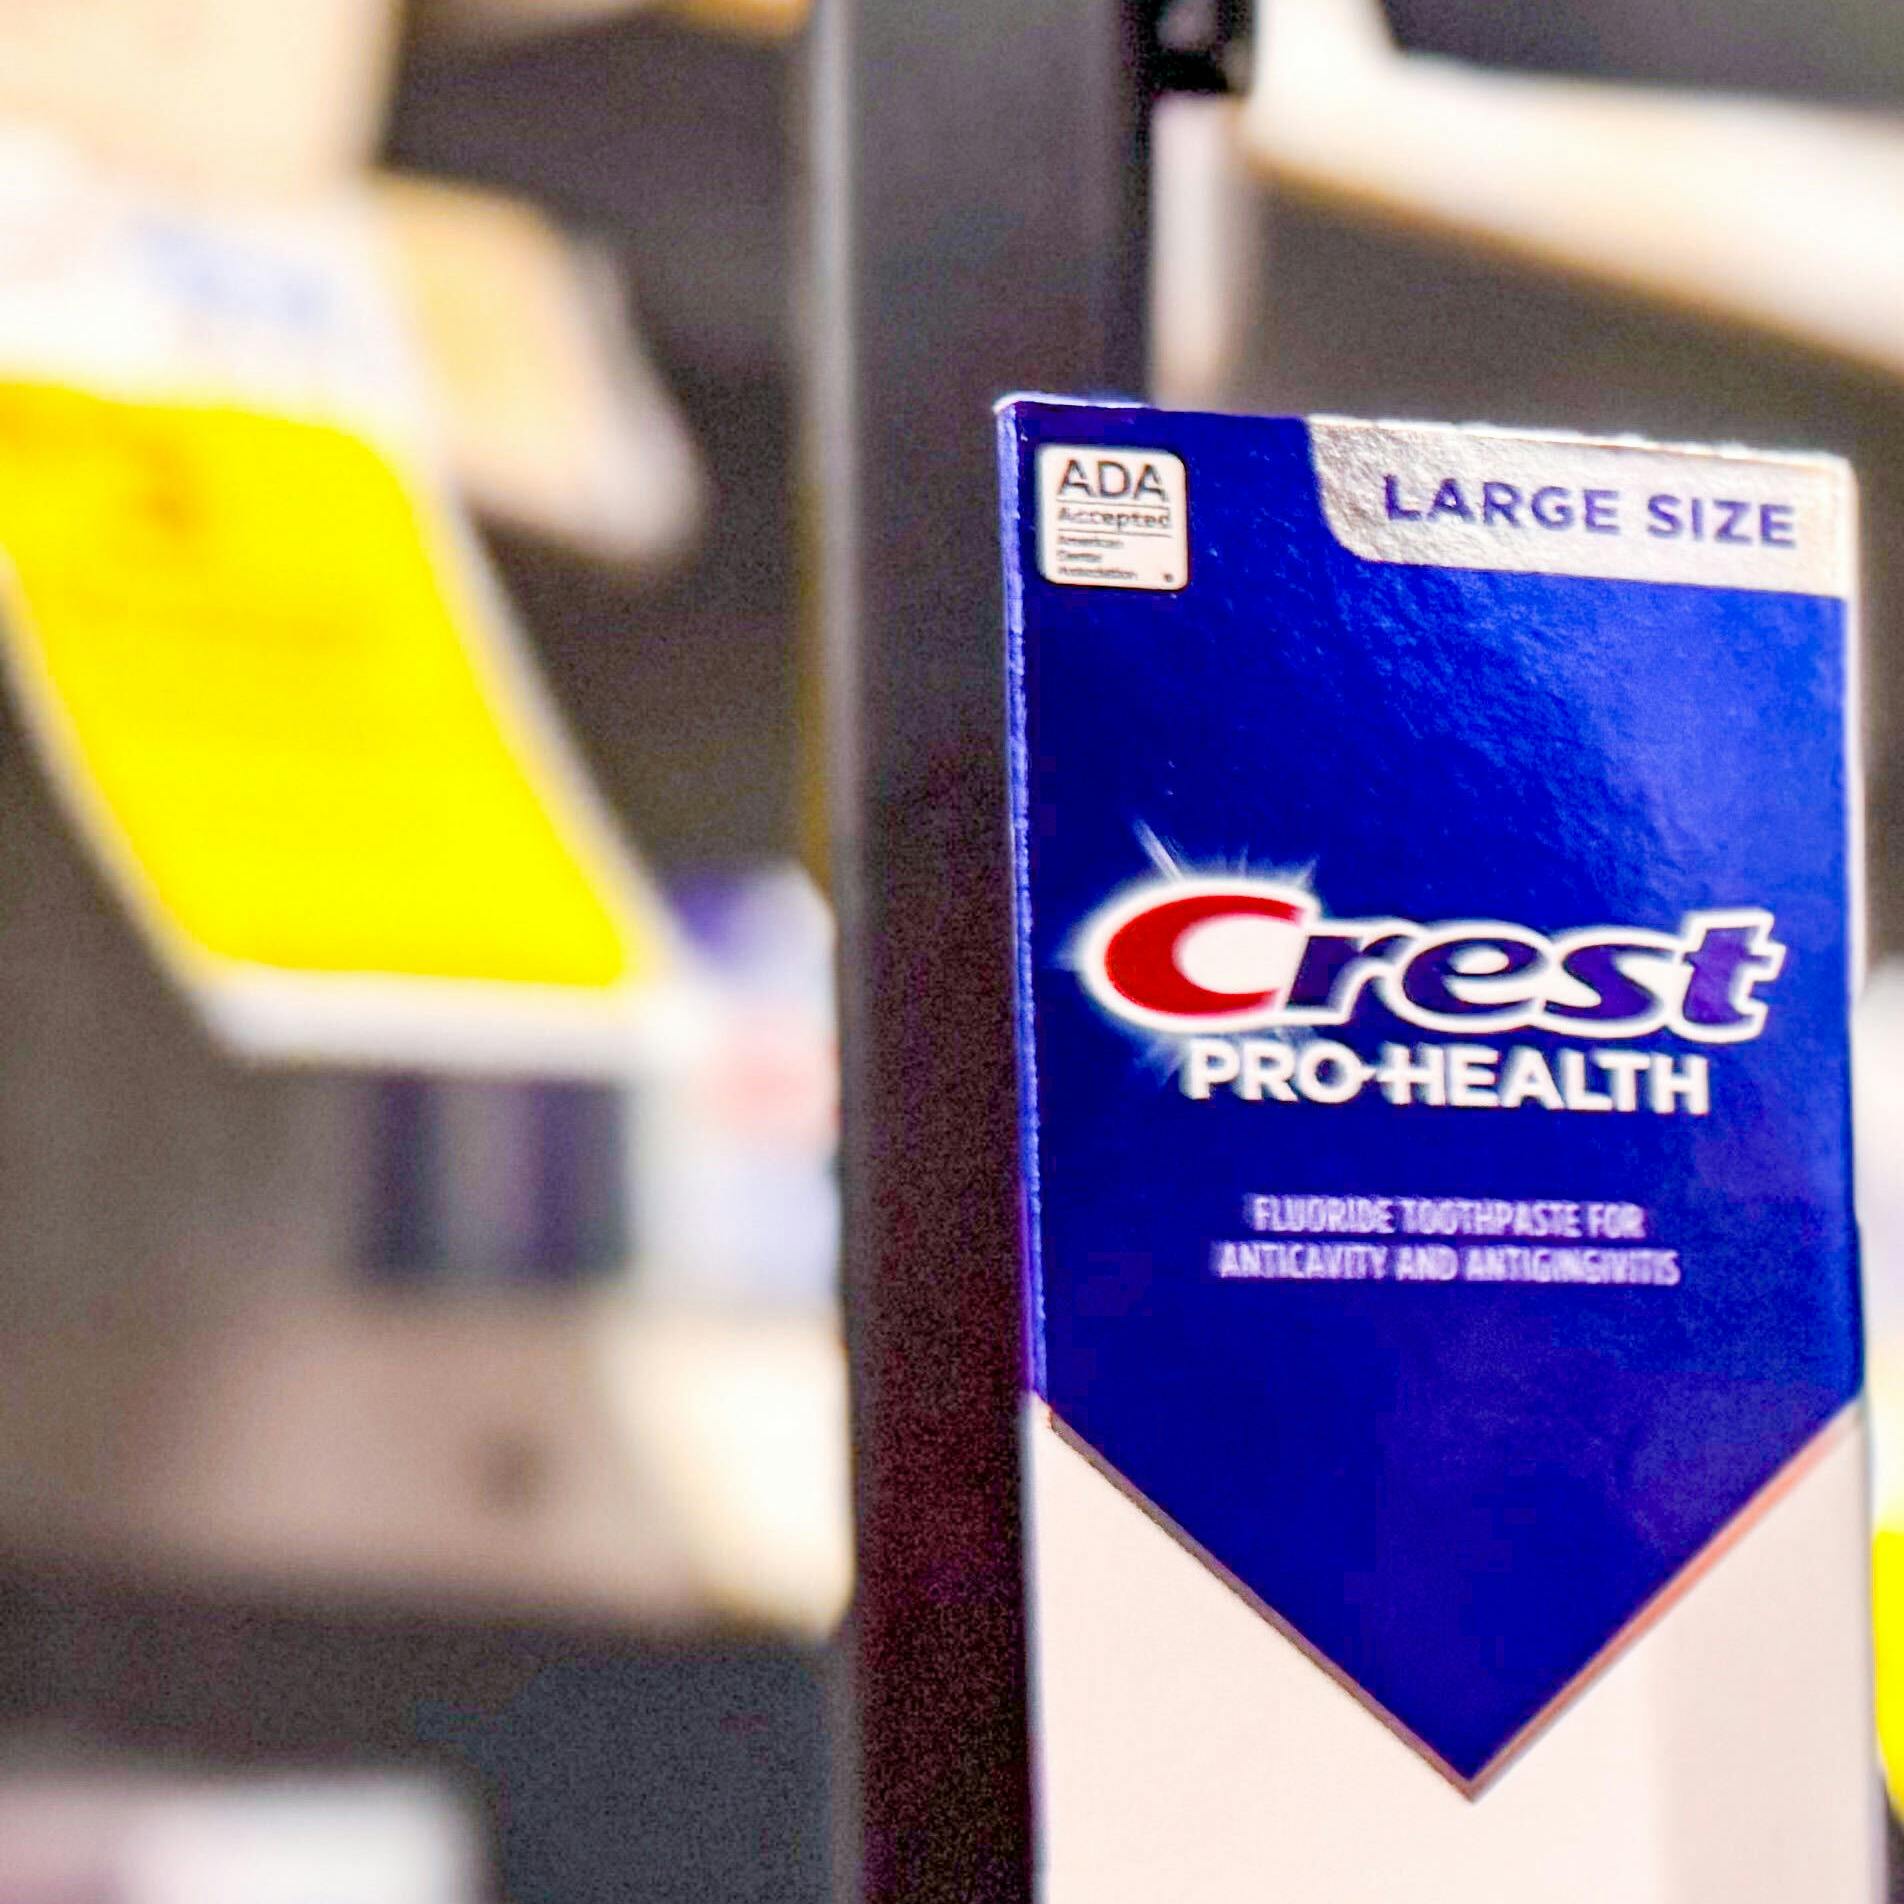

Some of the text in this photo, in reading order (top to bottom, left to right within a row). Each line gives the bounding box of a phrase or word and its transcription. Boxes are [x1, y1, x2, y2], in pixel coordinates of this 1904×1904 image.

[1057, 459, 1170, 501] ADA
[1385, 473, 1796, 548] LARGE SIZE
[1095, 884, 1782, 1038] Crest
[1186, 1040, 1708, 1114] PRO-HEALTH
[1243, 1194, 1647, 1239] FLUORIDE TOOTHPASTE FOR
[1212, 1240, 1388, 1280] ANTICAVITY
[1395, 1243, 1459, 1282] AND
